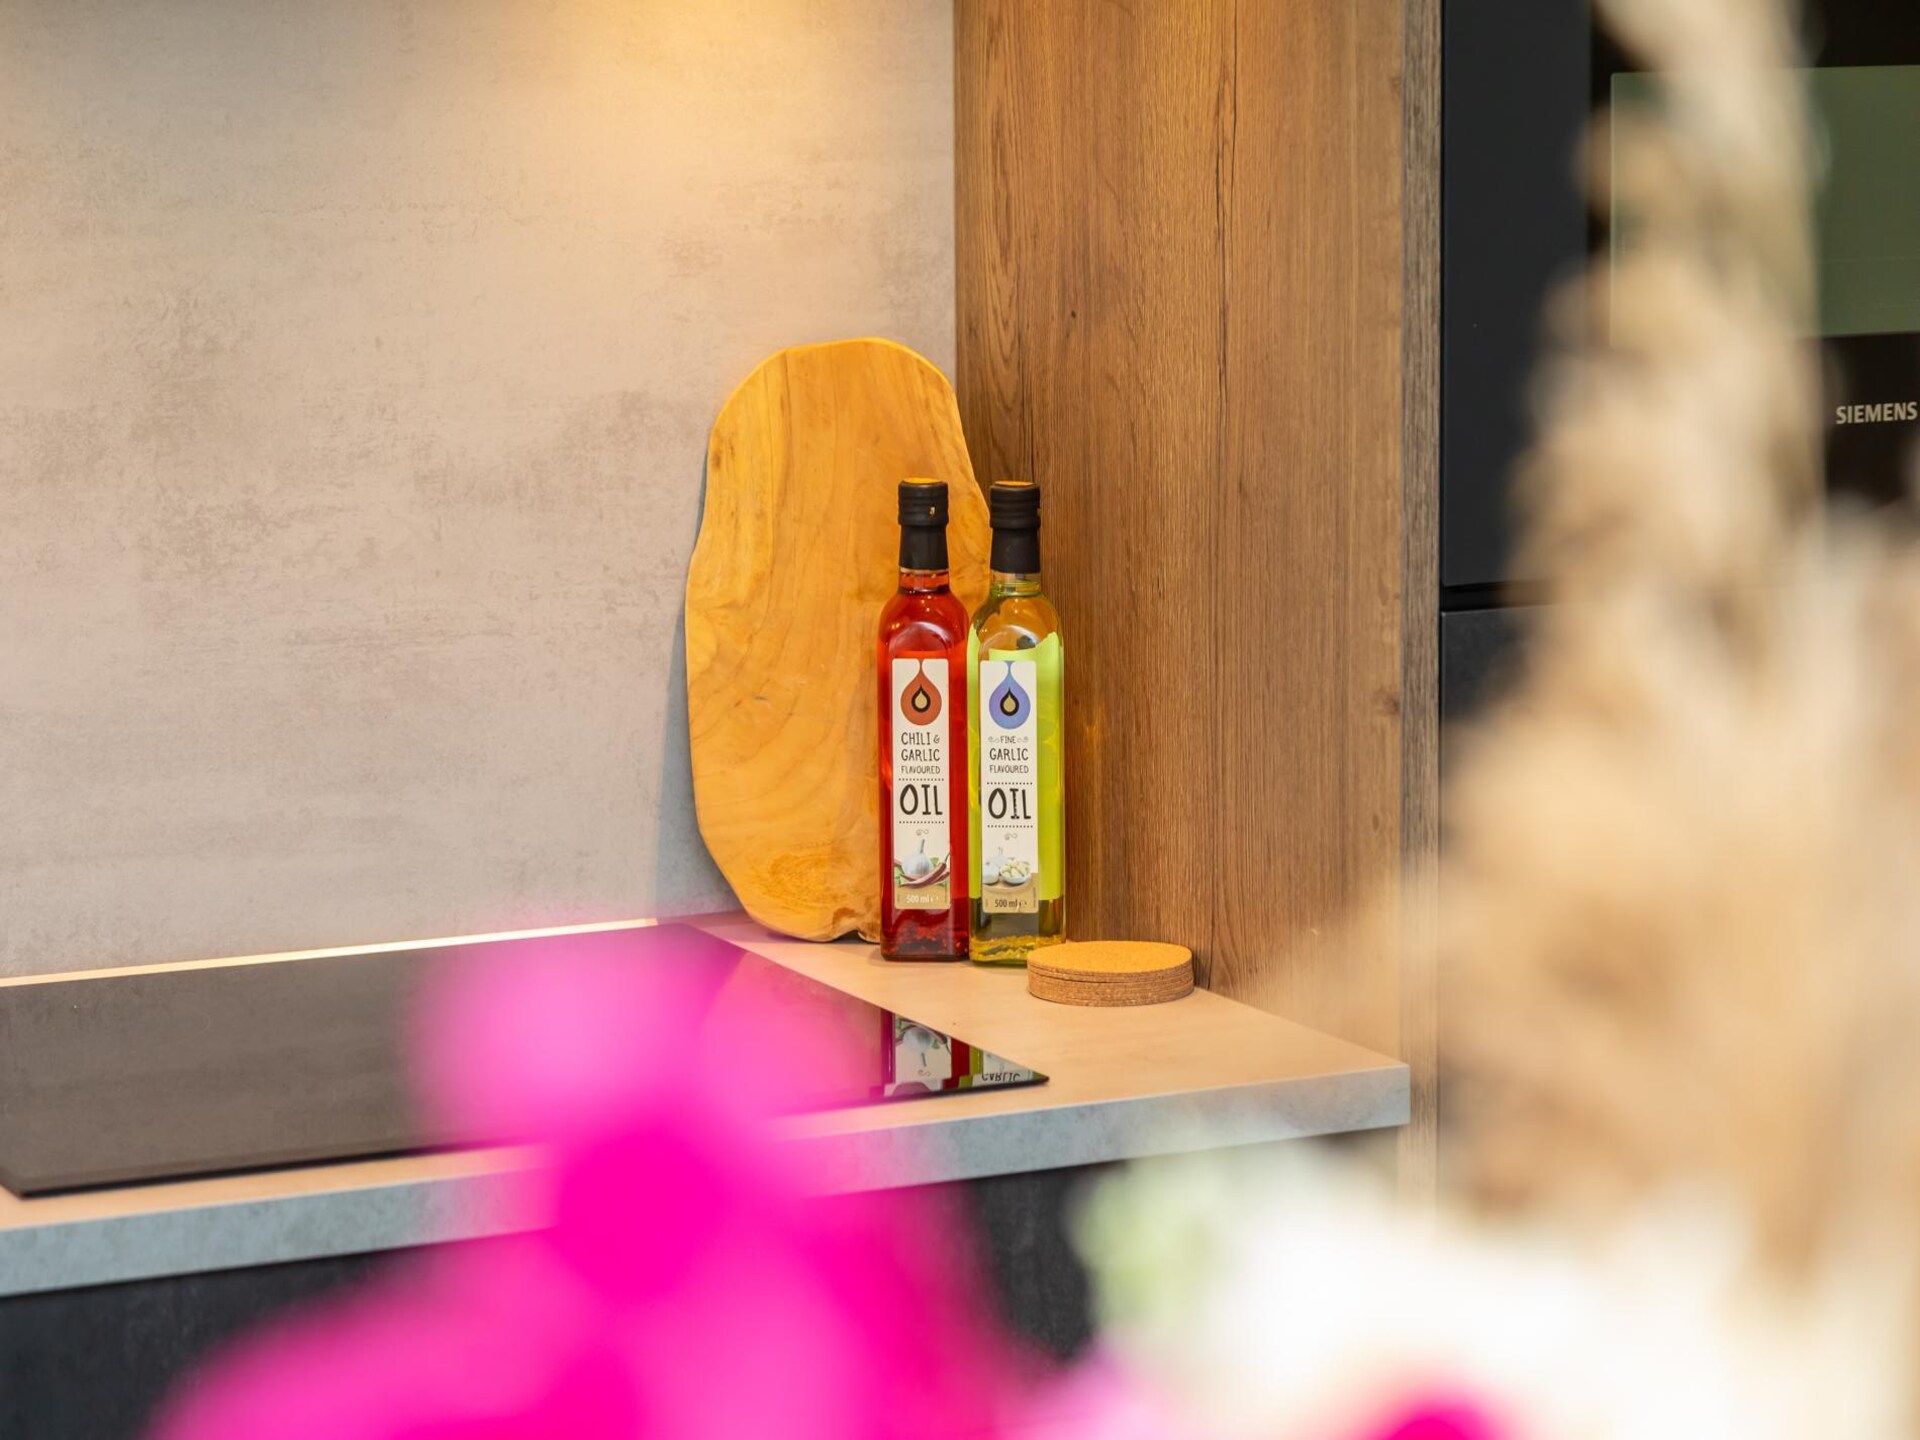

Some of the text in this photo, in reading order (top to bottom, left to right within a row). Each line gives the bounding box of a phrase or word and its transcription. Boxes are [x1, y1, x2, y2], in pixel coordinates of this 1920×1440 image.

[1836, 401, 1918, 424] SIEMENS
[901, 731, 941, 745] CHILI &
[1000, 735, 1017, 744] FINE
[901, 748, 941, 761] GARLIC
[989, 747, 1029, 761] GARLIC
[901, 765, 941, 774] FLAVOURED
[989, 764, 1029, 774] FLAVOURED
[899, 784, 943, 815] OIL
[988, 787, 1031, 819] OIL
[906, 894, 920, 903] 500
[994, 899, 1008, 908] 500
